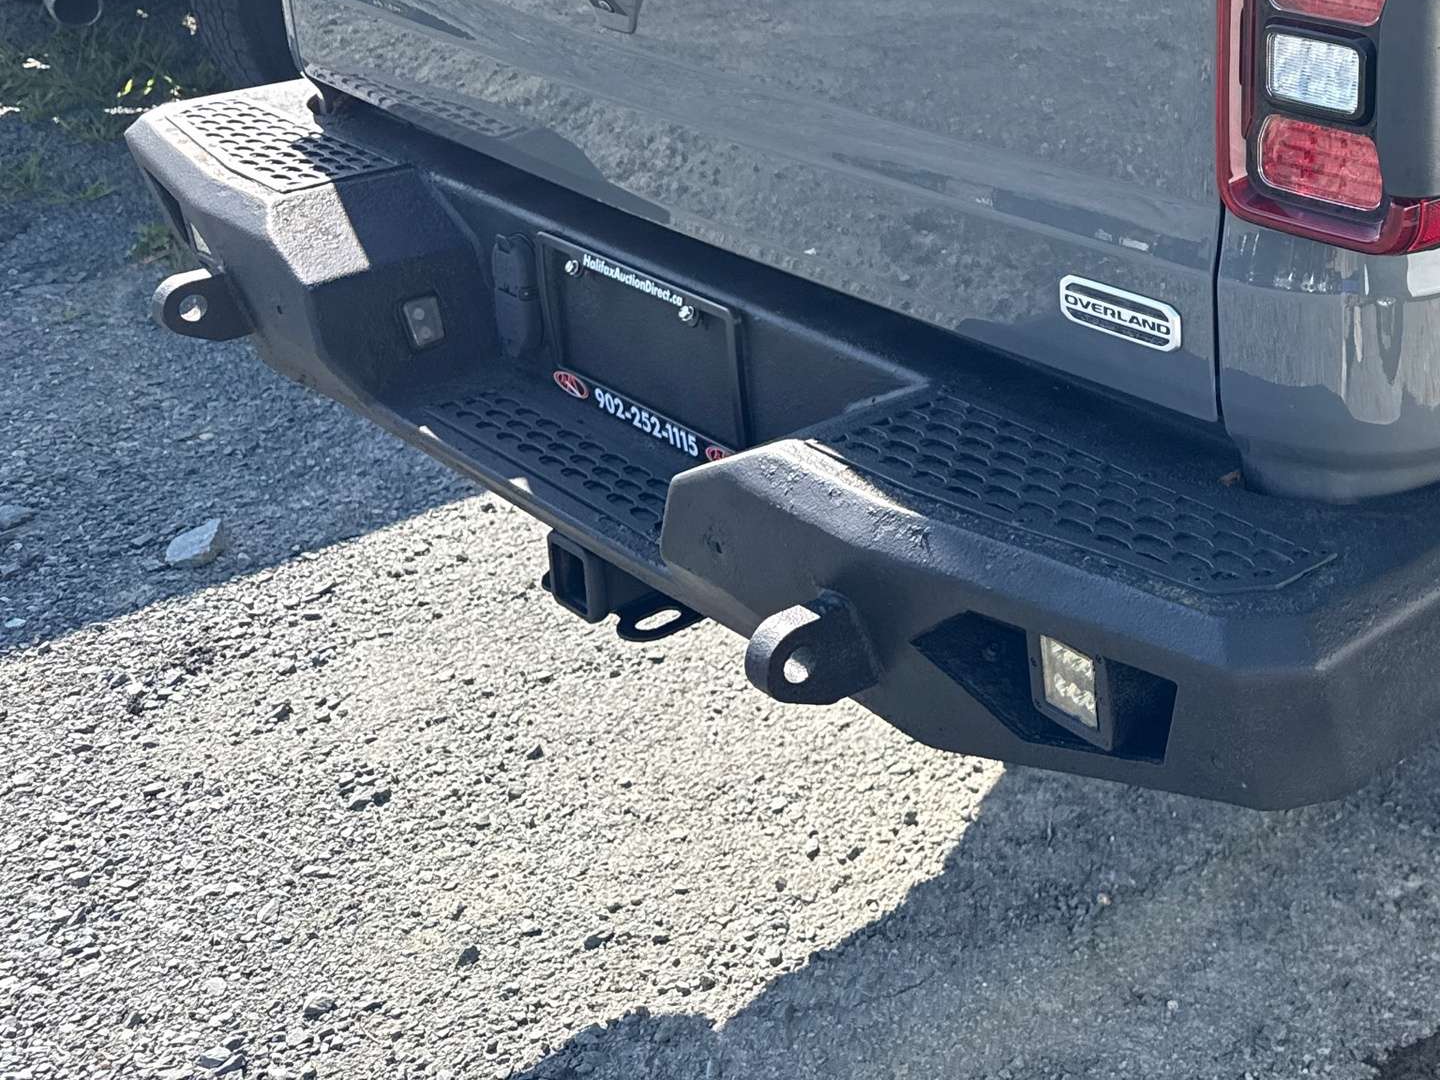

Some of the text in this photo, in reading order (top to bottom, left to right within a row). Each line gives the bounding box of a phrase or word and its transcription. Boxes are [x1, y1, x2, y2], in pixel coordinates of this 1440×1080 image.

[583, 254, 683, 306] HalifaxAuctionDirect.ca
[1064, 293, 1171, 336] OVERLAND
[594, 387, 700, 457] 902-252-1115
